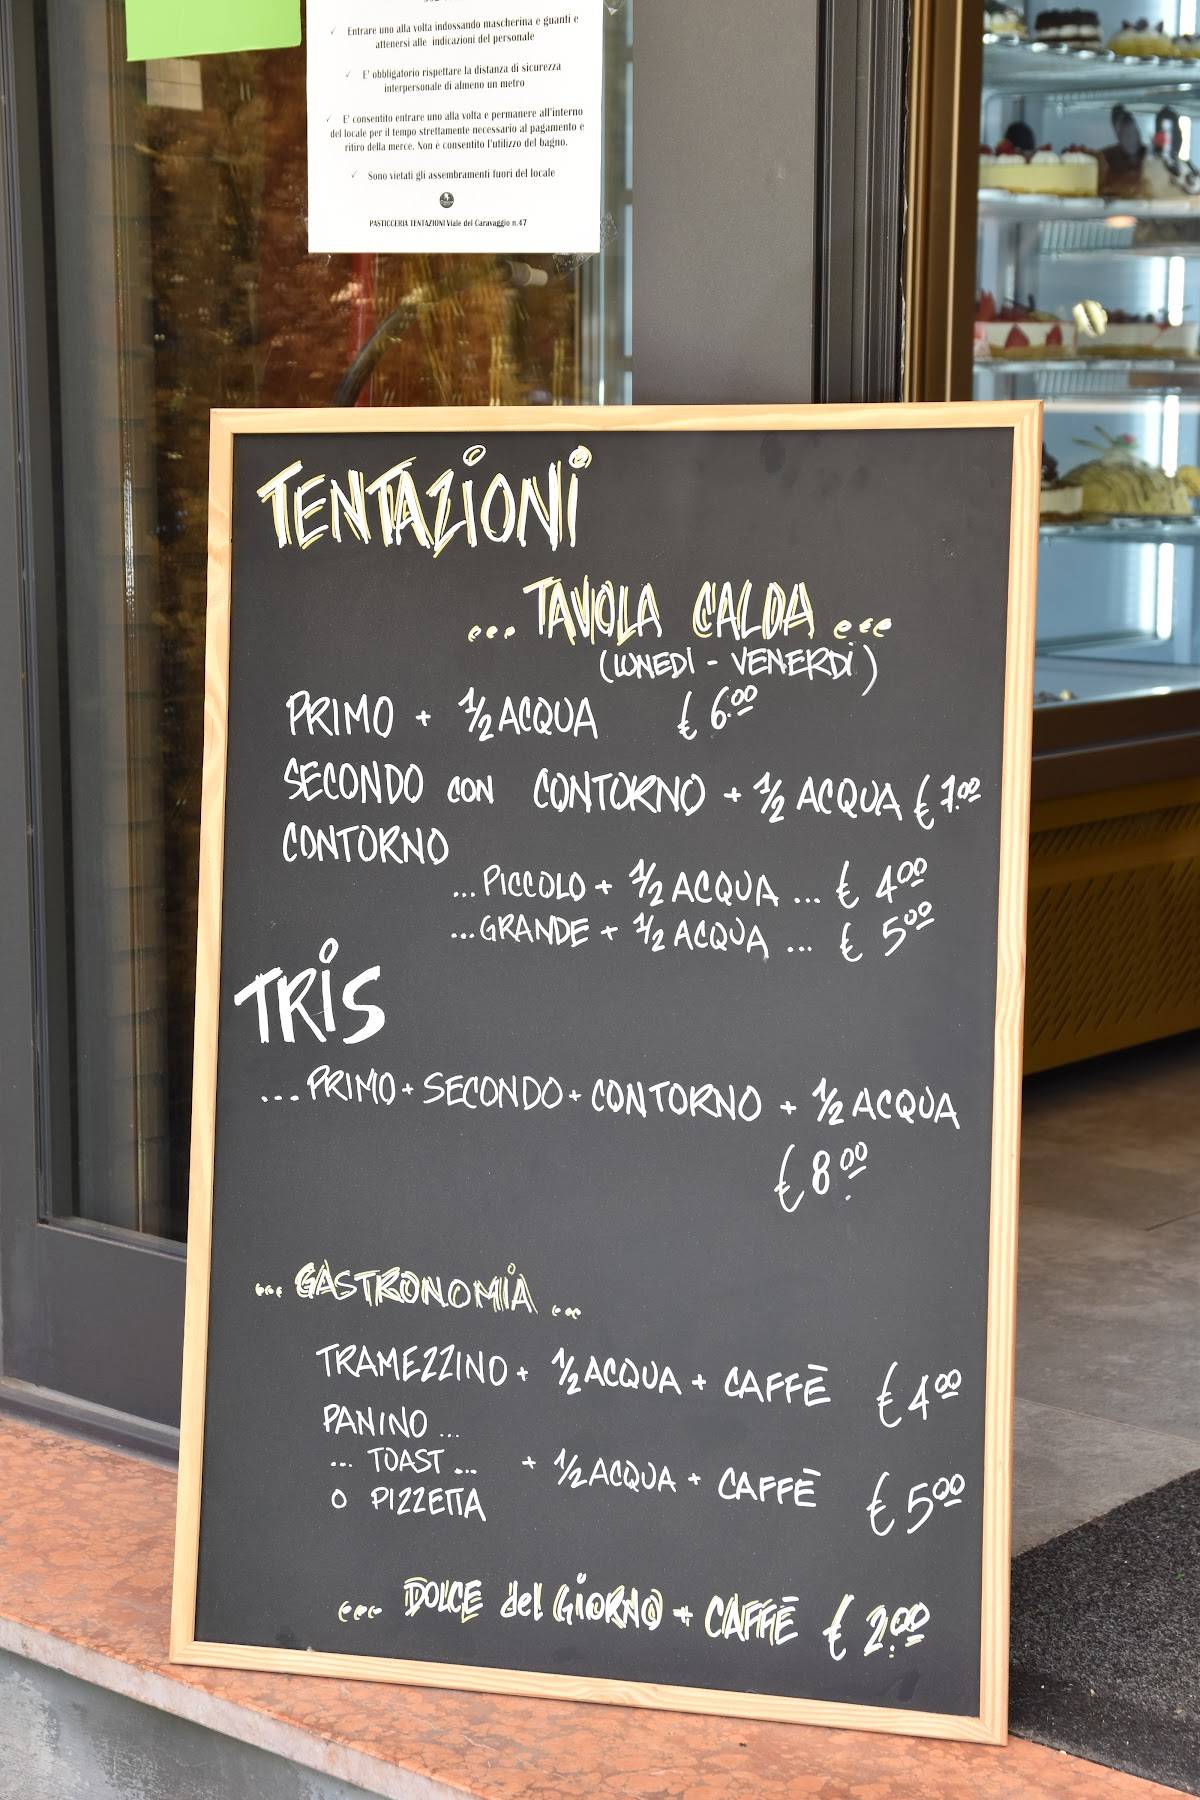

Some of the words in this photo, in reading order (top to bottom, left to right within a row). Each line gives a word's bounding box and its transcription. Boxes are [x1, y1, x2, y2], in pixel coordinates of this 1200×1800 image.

[347, 27, 376, 35] Entrare
[396, 24, 410, 33] alla
[413, 23, 432, 32] volta
[434, 20, 480, 31] indossando
[483, 17, 532, 28] mascherina
[543, 14, 570, 27] guanti
[375, 40, 410, 48] attenersi
[412, 38, 426, 47] alle
[432, 35, 475, 46] indicazioni
[477, 34, 490, 43] del
[492, 32, 534, 44] personale
[372, 68, 419, 80] obbligatorio
[422, 67, 461, 78] rispettare
[464, 66, 471, 74] la
[474, 65, 508, 74] distanza
[510, 63, 518, 72] di
[521, 63, 561, 72] sicurezza
[384, 82, 441, 94] interpersonale
[444, 81, 451, 90] di
[454, 81, 484, 90] almeno
[500, 79, 524, 88] metro
[330, 129, 341, 138] del
[344, 129, 366, 137] locale
[369, 130, 382, 139] per
[384, 128, 389, 136] il
[392, 129, 416, 138] tempo
[418, 126, 469, 135] strettamente
[472, 124, 517, 134] necessario
[519, 124, 527, 133] al
[529, 123, 576, 134] pagamento
[352, 114, 392, 123] consentito
[395, 114, 424, 122] entrare
[444, 111, 459, 120] alla
[461, 111, 481, 119] volta
[491, 111, 536, 121] permanere
[539, 107, 583, 117] all'interno
[344, 143, 364, 151] ritiro
[366, 142, 385, 151] della
[417, 141, 432, 150] Non
[442, 139, 484, 149] consentito
[487, 139, 521, 148] l'utilizzo
[524, 138, 536, 147] del
[539, 138, 567, 148] bagno.
[389, 171, 413, 179] vietati
[415, 170, 425, 181] gli
[428, 169, 489, 179] assembramenti
[492, 169, 512, 178] fuori
[515, 169, 527, 177] del
[530, 168, 555, 177] locale
[474, 220, 510, 228] Caravaggio
[523, 575, 662, 646] TAVOLA
[693, 580, 814, 640] CALDA
[286, 691, 393, 738] PRIMO
[677, 691, 697, 740] €
[284, 758, 423, 804] SECONDO
[534, 768, 705, 816] CONTORNO
[914, 774, 934, 830] €
[283, 822, 448, 865] CONTORNO
[836, 861, 859, 909] €
[840, 922, 863, 962] €
[424, 1072, 563, 1110] SECONDO
[592, 1079, 761, 1121] CONTORNO
[774, 1144, 804, 1212] €
[316, 1344, 507, 1386] TRAMEZZINO
[877, 1362, 902, 1428] €
[323, 1404, 427, 1438] PANINO
[367, 1447, 444, 1474] TOAST
[866, 1472, 894, 1536] €
[371, 1487, 486, 1521] PIZZETTA
[404, 1577, 483, 1623] DOLCE
[500, 1580, 543, 1621] del
[823, 1594, 854, 1661] €
